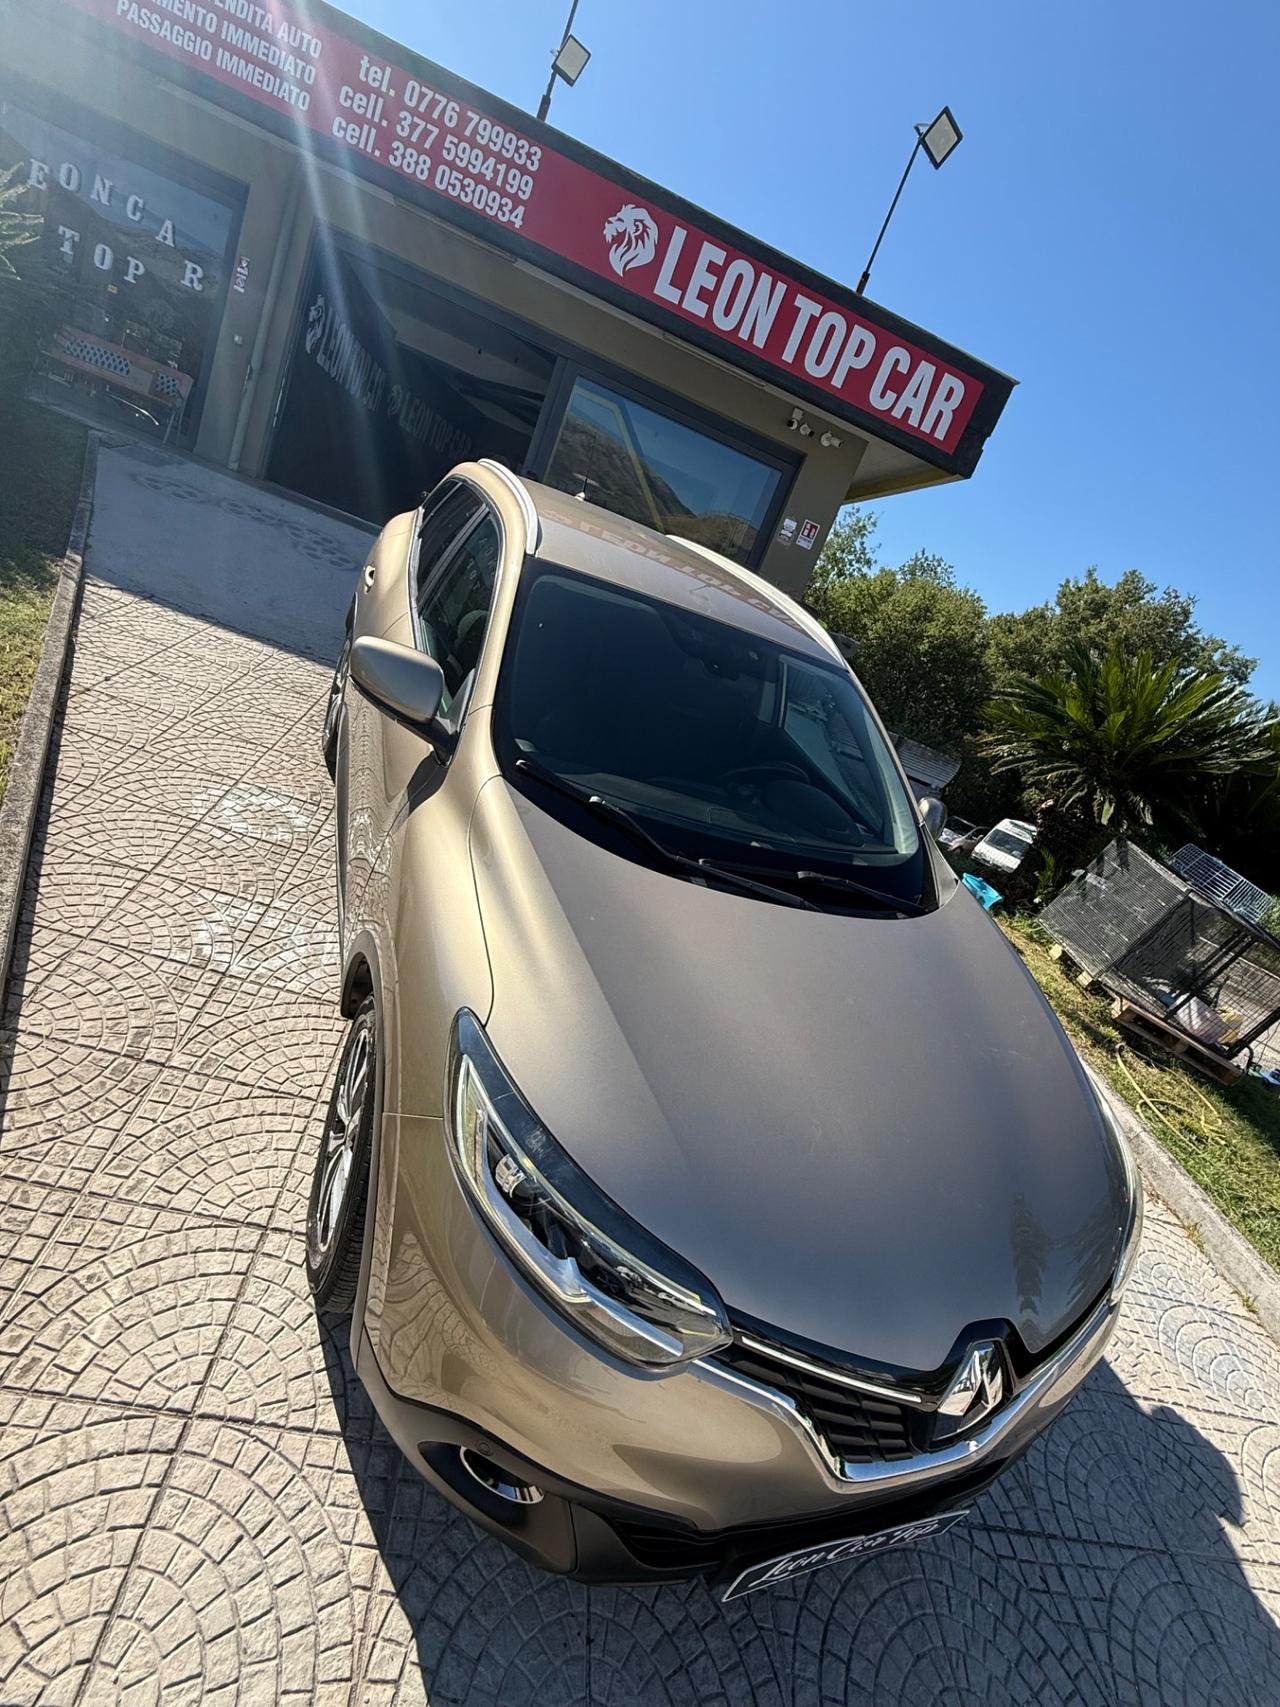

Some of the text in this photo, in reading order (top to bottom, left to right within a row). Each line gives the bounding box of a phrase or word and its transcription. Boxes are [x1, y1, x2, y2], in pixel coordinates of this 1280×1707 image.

[116, 0, 310, 111] PASSAGGIO IMMEDIATO
[152, 0, 316, 85] MENTO IMMEDIATO
[277, 22, 322, 58] AUTO
[339, 85, 534, 200] cell. 377 5994199
[359, 56, 542, 171] tel. 0776 799933
[332, 116, 525, 229] cell. 388 0530934
[58, 224, 146, 284] TOP
[653, 225, 966, 441] LEON TOP CAR
